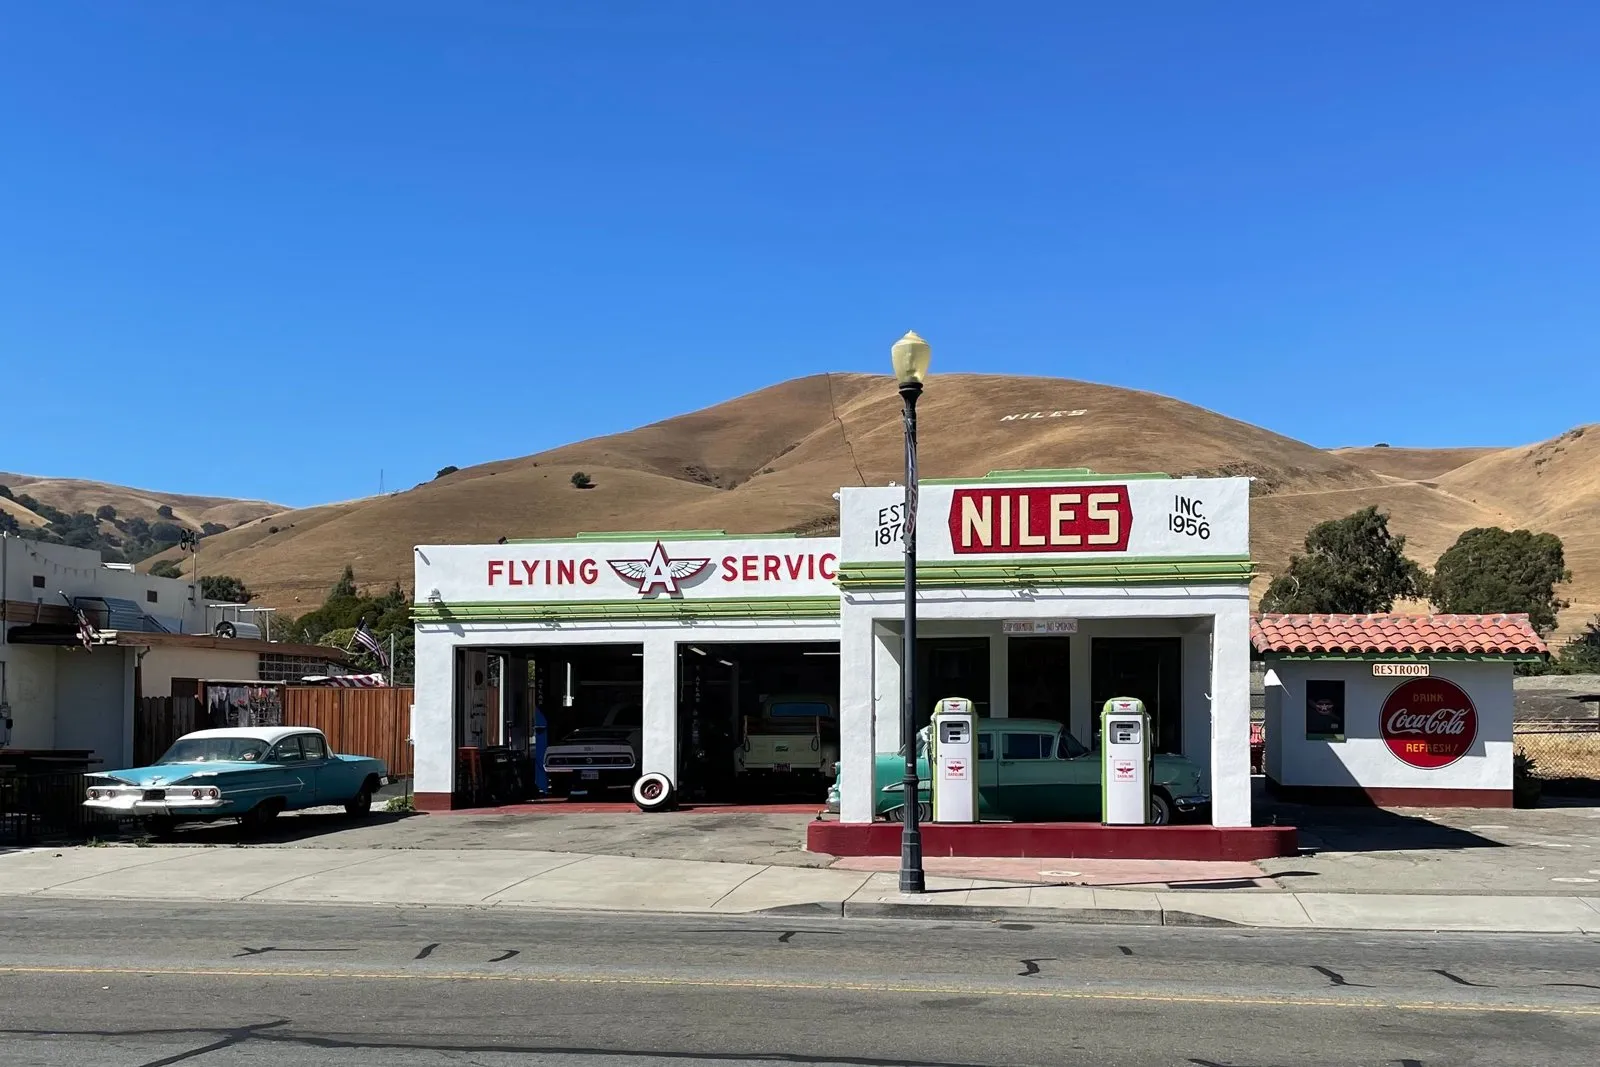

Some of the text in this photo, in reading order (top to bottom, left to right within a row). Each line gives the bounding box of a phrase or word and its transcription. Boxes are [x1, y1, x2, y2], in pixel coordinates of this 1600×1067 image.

[999, 409, 1088, 421] NILES
[961, 492, 1120, 548] NILES
[1174, 494, 1206, 520] INC.
[1168, 512, 1211, 540] 1956
[488, 559, 599, 585] FLYING
[1374, 664, 1428, 675] RESTROOM
[1413, 693, 1444, 703] DRINK
[1387, 708, 1471, 735] Coca-Cola
